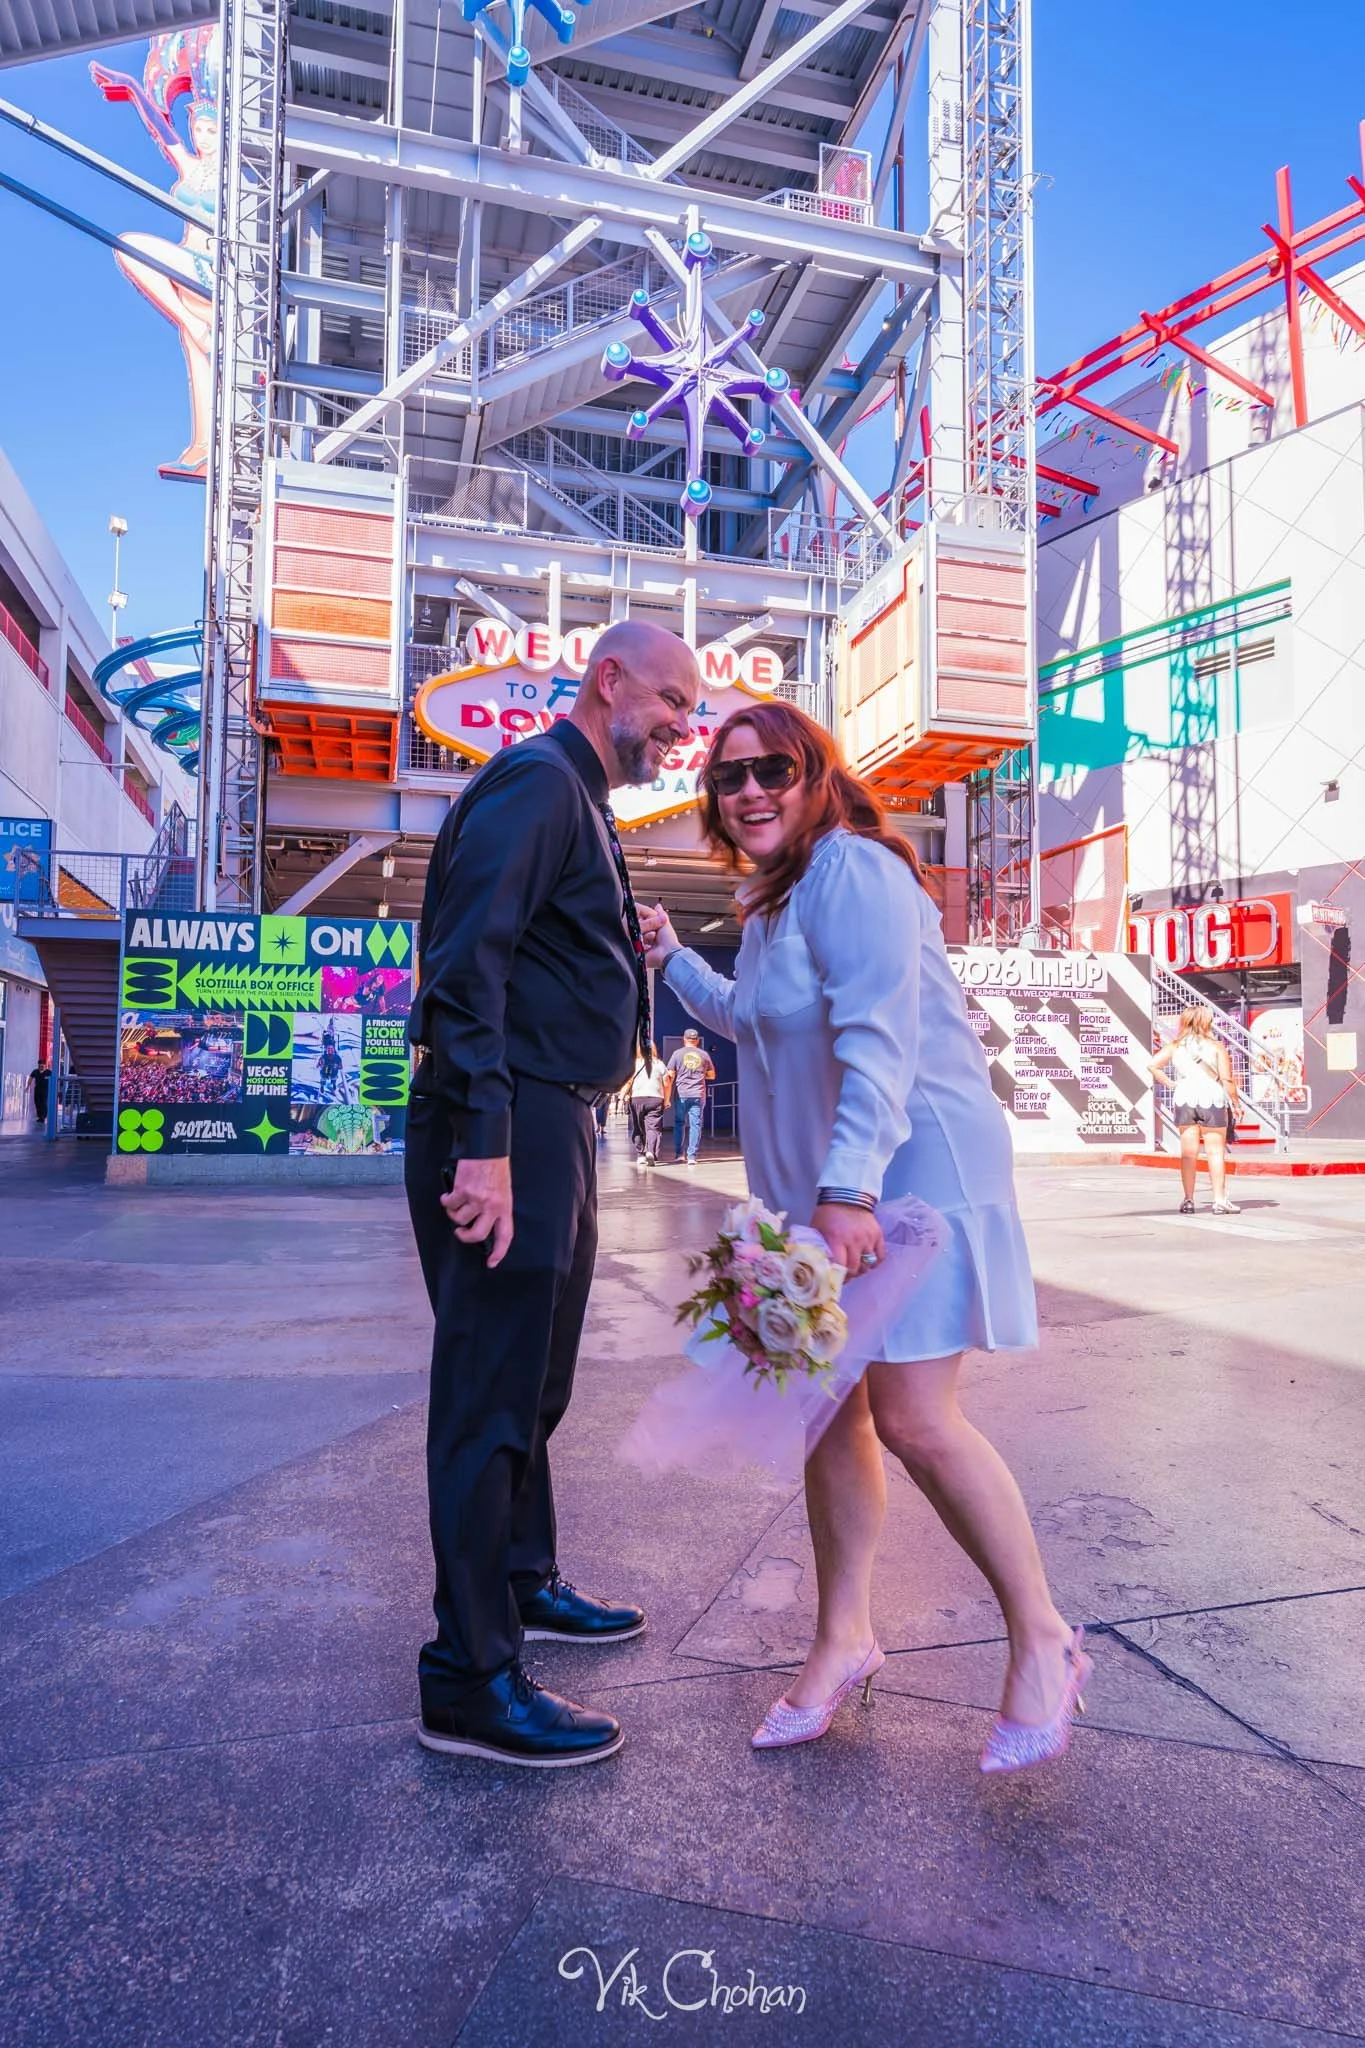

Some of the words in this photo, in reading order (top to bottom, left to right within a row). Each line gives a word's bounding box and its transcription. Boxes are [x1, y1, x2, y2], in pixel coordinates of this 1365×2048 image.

[475, 627, 771, 684] WELME
[505, 682, 537, 700] TO
[129, 917, 255, 953] ALWAYS
[311, 925, 363, 956] ON
[952, 960, 1021, 986] 2026
[1024, 960, 1104, 989] LINEUP
[195, 977, 246, 990] SLOTZILLA
[250, 980, 273, 990] BOX
[277, 980, 315, 992] OFFICE
[372, 1019, 406, 1027] FREMONT
[1014, 1013, 1047, 1022] GEORGE
[1047, 1014, 1069, 1023] BIRGE
[1080, 1015, 1111, 1024] PROTOJE
[365, 1027, 405, 1039] STORY
[391, 1039, 405, 1047] TELL
[1014, 1036, 1047, 1045] SLEEPING
[1080, 1035, 1101, 1043] CARLY
[1102, 1035, 1128, 1044] PEARCE
[365, 1046, 404, 1056] FOREVER
[1015, 1046, 1032, 1055] WITH
[1034, 1046, 1057, 1055] SIRENS
[1080, 1046, 1105, 1054] LAUREN
[247, 1065, 289, 1077] VEGAS'
[1015, 1069, 1044, 1078] HAYDAY
[1045, 1069, 1073, 1078] PARADE
[1081, 1065, 1093, 1074] THE
[1093, 1066, 1112, 1075] USED
[246, 1084, 288, 1096] ZIPLINE
[1015, 1092, 1039, 1101] STORY
[1040, 1092, 1051, 1101] OF
[1016, 1102, 1028, 1110] THE
[1029, 1102, 1047, 1110] YEAR
[1081, 1111, 1131, 1125] SUMMER
